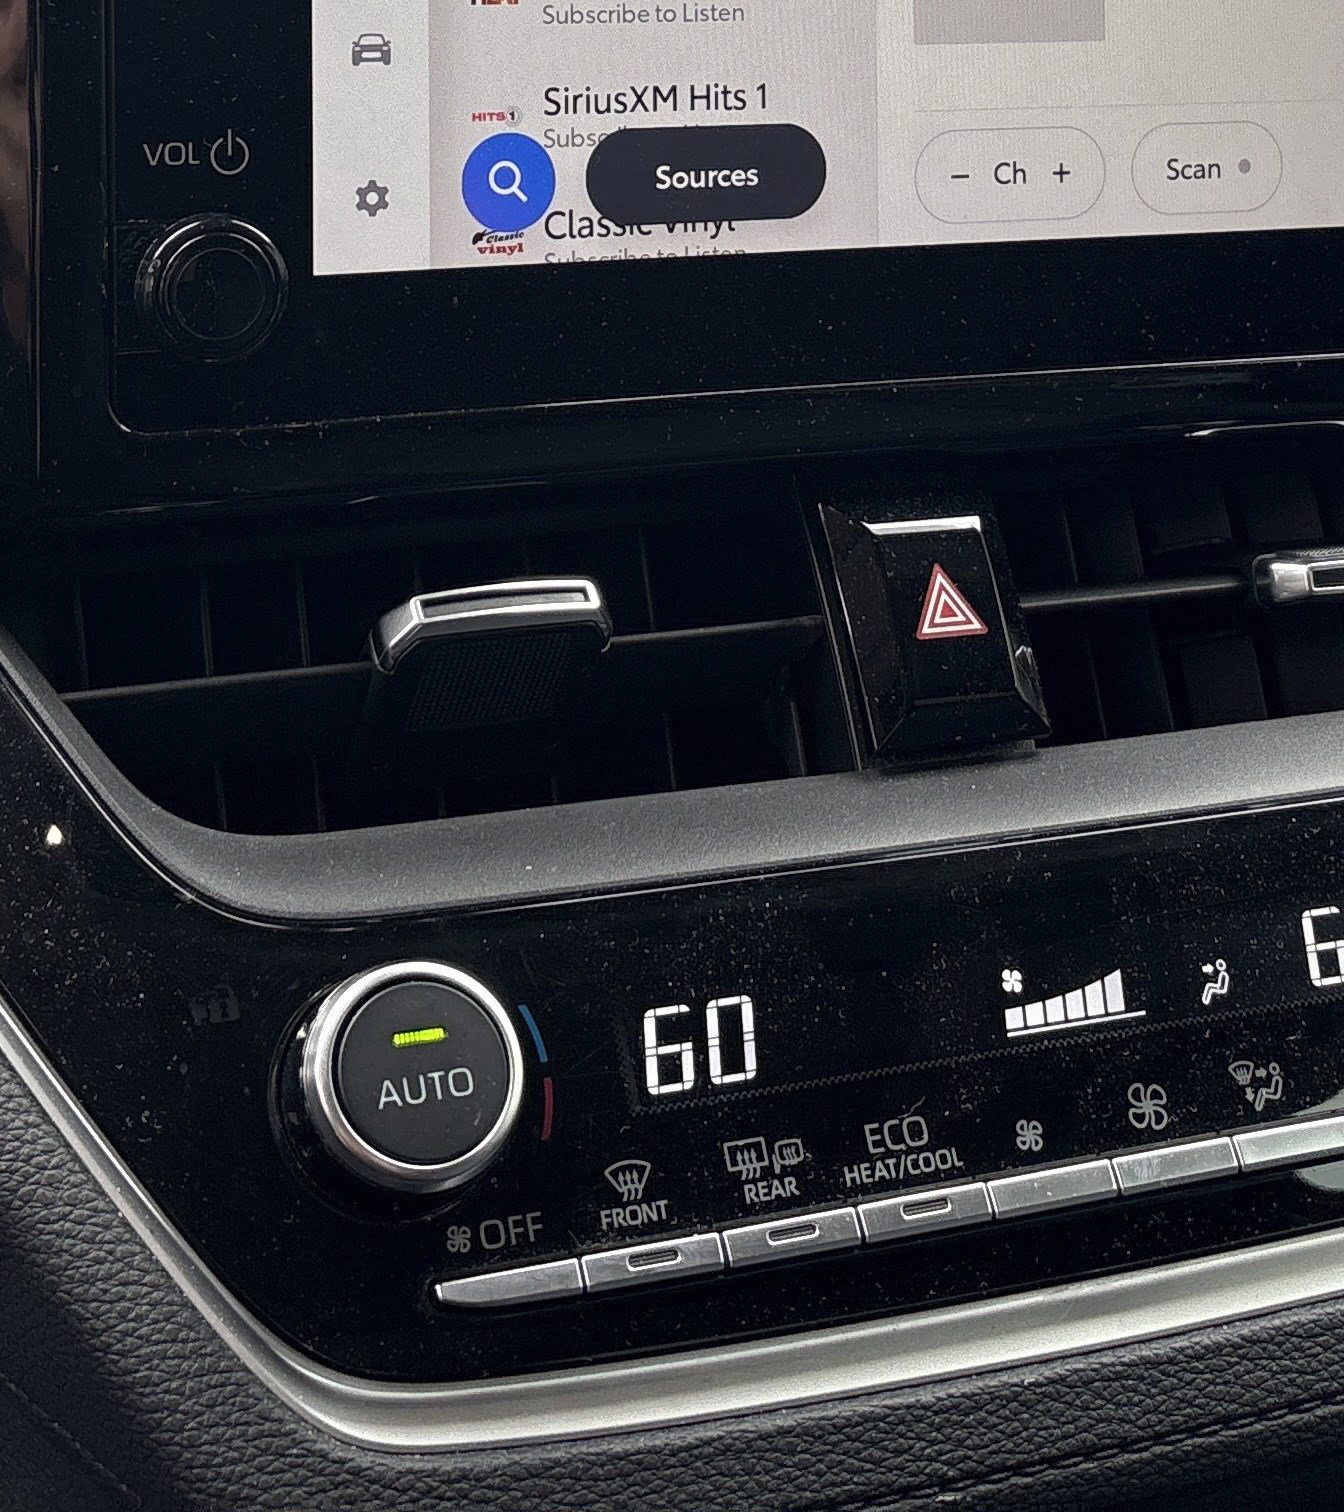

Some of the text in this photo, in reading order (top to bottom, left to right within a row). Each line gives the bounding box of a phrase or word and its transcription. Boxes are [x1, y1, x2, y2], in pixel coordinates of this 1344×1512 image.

[542, 2, 745, 25] Subscribe to Listen
[543, 82, 766, 116] SiriusXM Hits 1
[472, 112, 506, 122] HITS
[543, 127, 607, 148] Subsc
[143, 142, 200, 166] VOL
[655, 165, 759, 190] Sources
[993, 160, 1027, 185] Ch
[1166, 158, 1221, 181] Scan
[477, 243, 524, 255] vinyl
[643, 994, 757, 1096] 60
[378, 1067, 474, 1110] AUTO
[863, 1115, 929, 1154] ECO
[842, 1145, 965, 1188] HEAT/COOL
[742, 1176, 801, 1205] REAR
[600, 1199, 668, 1230] FRONT
[479, 1211, 543, 1250] OFF
